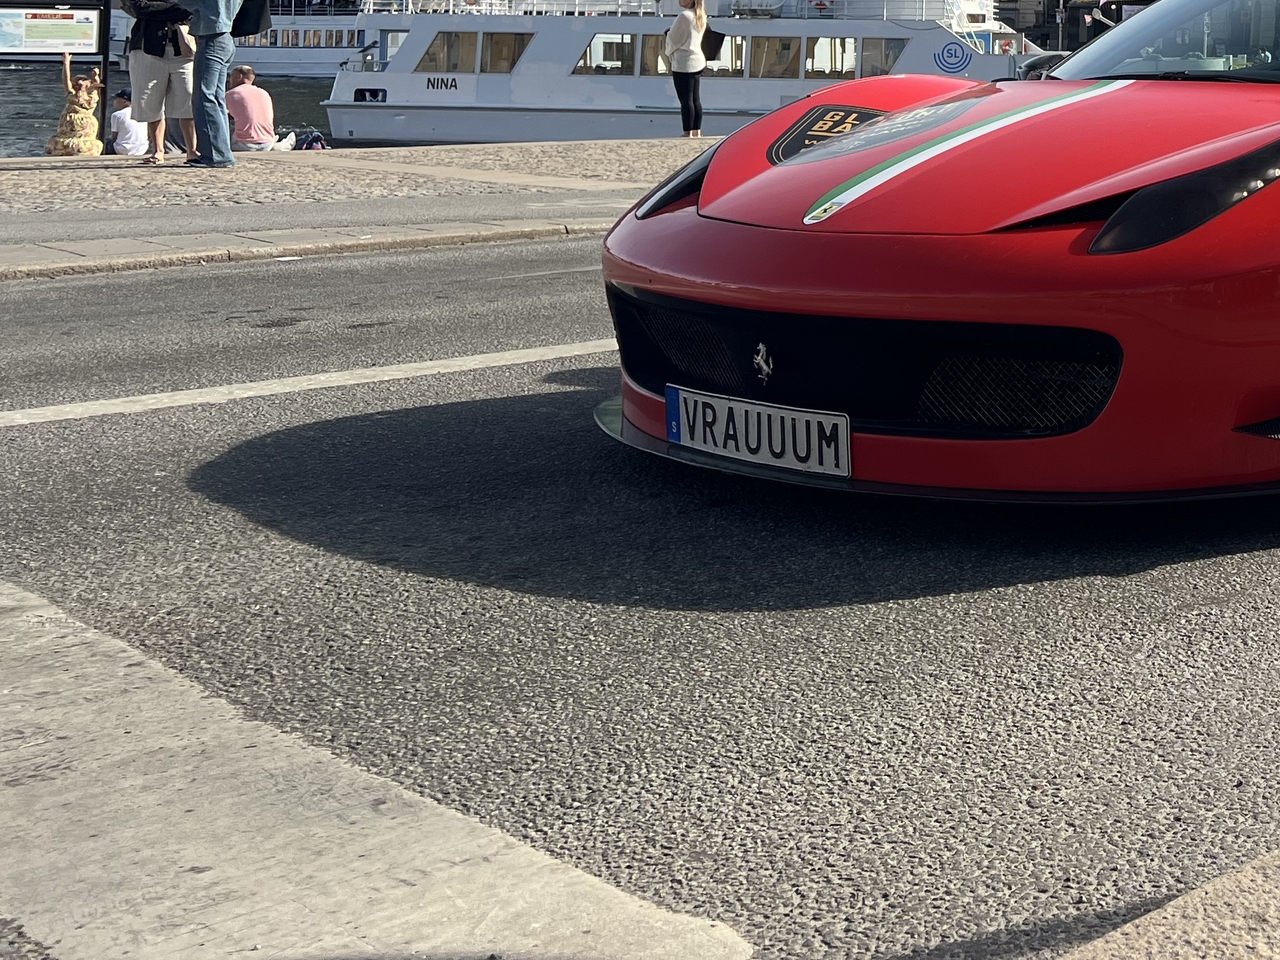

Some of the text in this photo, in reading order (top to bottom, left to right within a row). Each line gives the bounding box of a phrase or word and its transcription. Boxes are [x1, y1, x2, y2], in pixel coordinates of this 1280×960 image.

[946, 48, 960, 58] SL
[426, 77, 458, 90] NINA
[671, 396, 840, 469] S VRAUUUM
